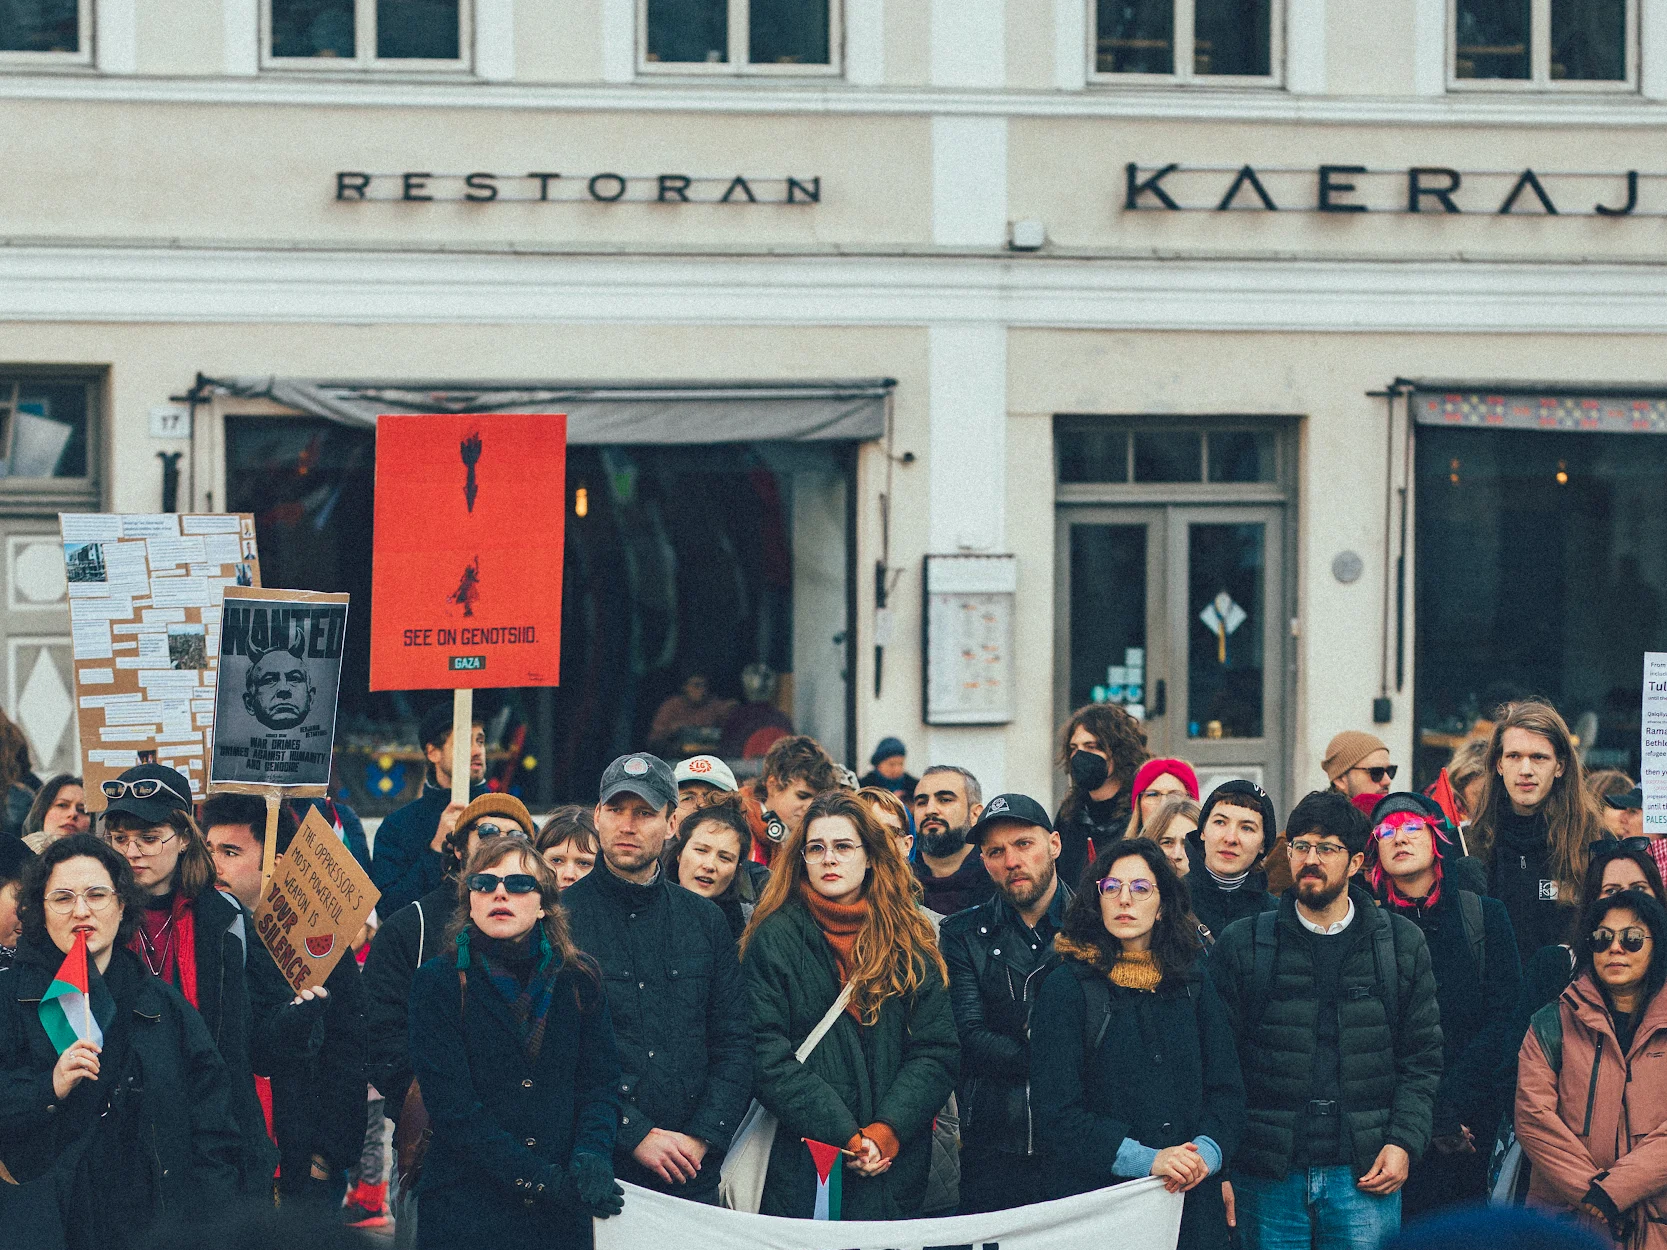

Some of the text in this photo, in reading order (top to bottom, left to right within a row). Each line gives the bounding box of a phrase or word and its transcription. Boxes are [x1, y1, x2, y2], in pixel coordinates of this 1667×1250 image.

[336, 172, 821, 204] RESTORAN
[1124, 162, 1639, 217] KAERAJ
[162, 415, 180, 430] 17
[222, 607, 346, 659] WANTED
[403, 626, 539, 646] SEE ON GENOTSIID.
[454, 657, 480, 669] GAZA
[1648, 681, 1667, 692] Tul
[250, 737, 301, 750] WAR CRIMES
[252, 750, 286, 761] AGAINST
[289, 751, 326, 765] HUMANITY
[246, 758, 261, 770] AND
[301, 824, 364, 911] THE OPPRESSOR'S
[284, 870, 319, 928] WEAPON IS
[291, 846, 345, 926] MOST POWERFUL
[267, 882, 299, 935] YOUR
[258, 913, 312, 991] SILENCE
